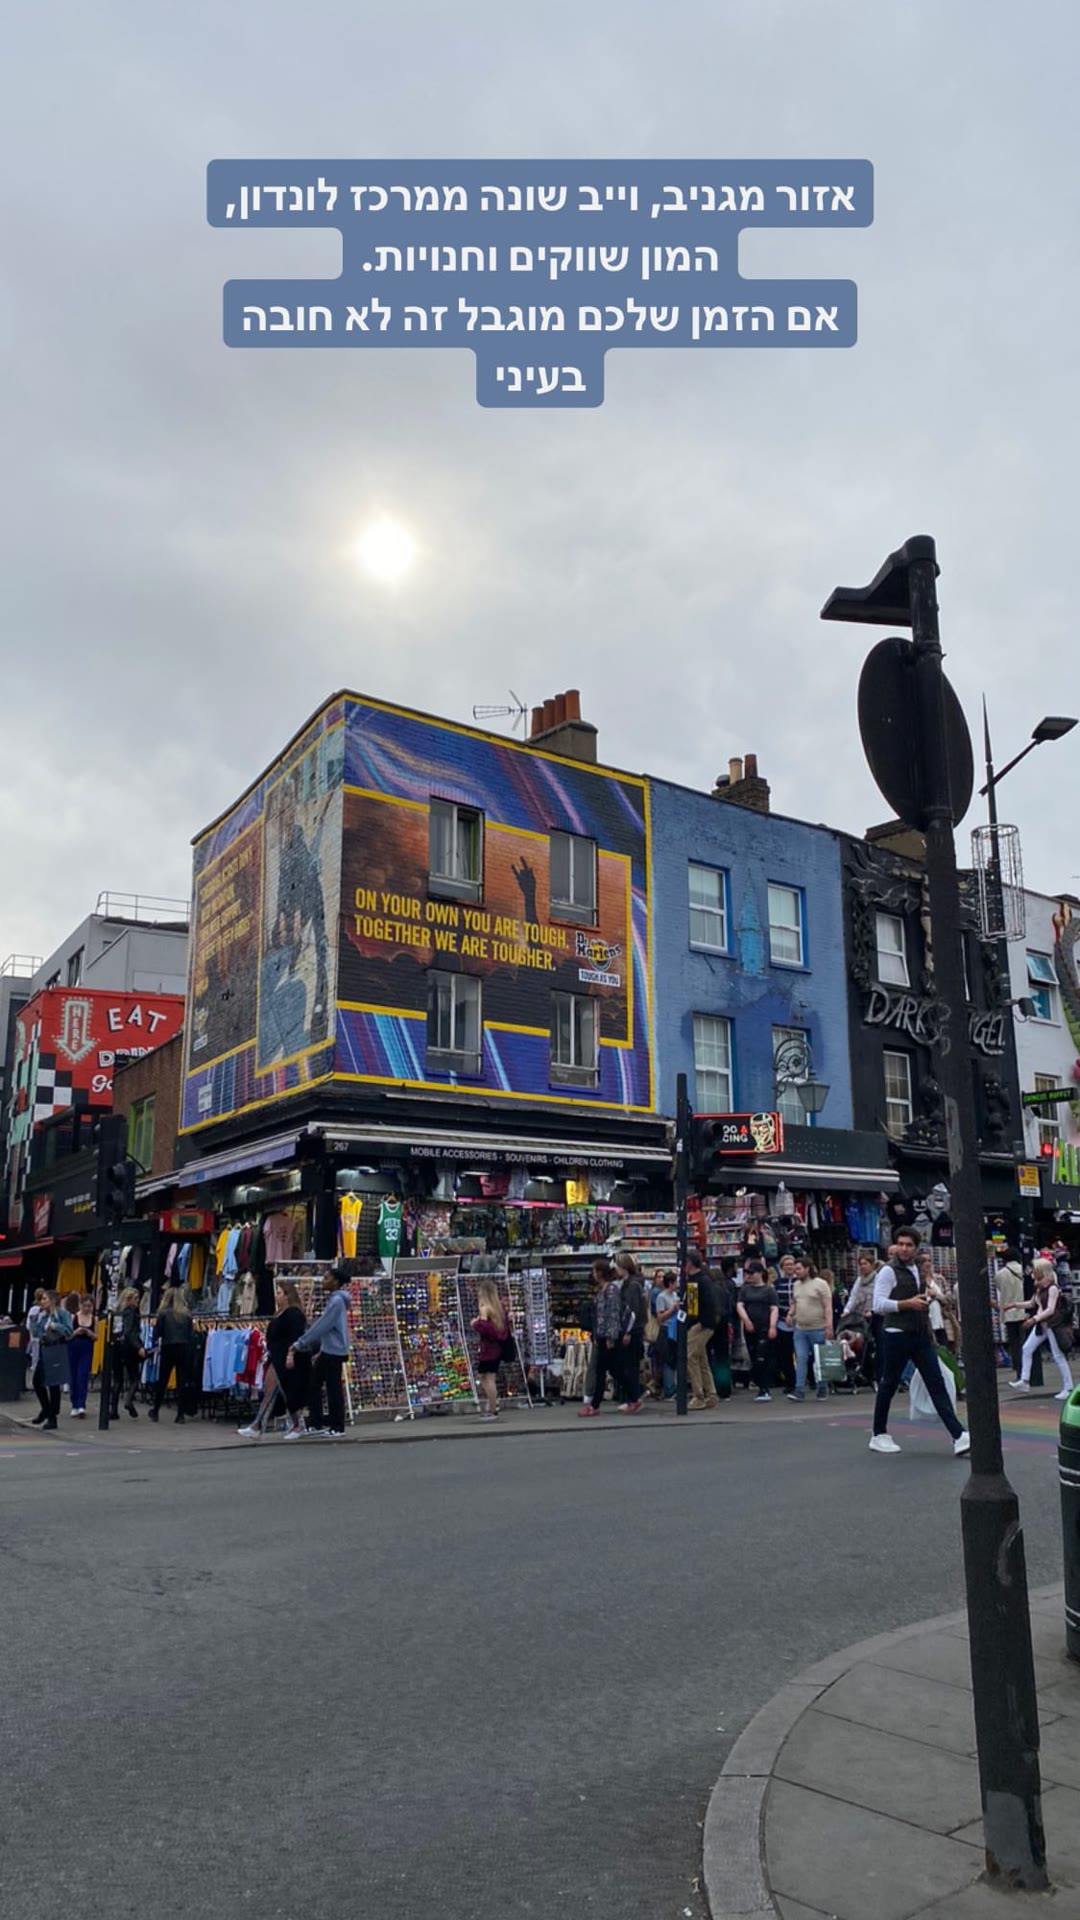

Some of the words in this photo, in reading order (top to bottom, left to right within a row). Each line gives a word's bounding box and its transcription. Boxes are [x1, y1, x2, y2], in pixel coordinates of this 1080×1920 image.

[355, 888, 377, 911] ON
[381, 894, 421, 919] YOUR
[425, 902, 459, 927] OWN
[463, 909, 490, 933] YOU
[494, 916, 519, 939] ARE
[523, 922, 569, 949] TOUGH.
[354, 914, 431, 948] TOGETHER
[434, 929, 457, 952] WE
[461, 935, 488, 958] ARE
[491, 940, 557, 971] TOUGHER.
[72, 1006, 81, 1050] HERE
[108, 1005, 167, 1033] EAT
[334, 1142, 349, 1151] 267
[410, 1146, 441, 1158] MOBILE
[442, 1149, 497, 1161] ACCESSORIES
[505, 1153, 547, 1164] SOUVENIRS
[553, 1156, 588, 1166] CHILDREN
[590, 1158, 624, 1169] CLOTHING
[386, 1228, 399, 1240] 33
